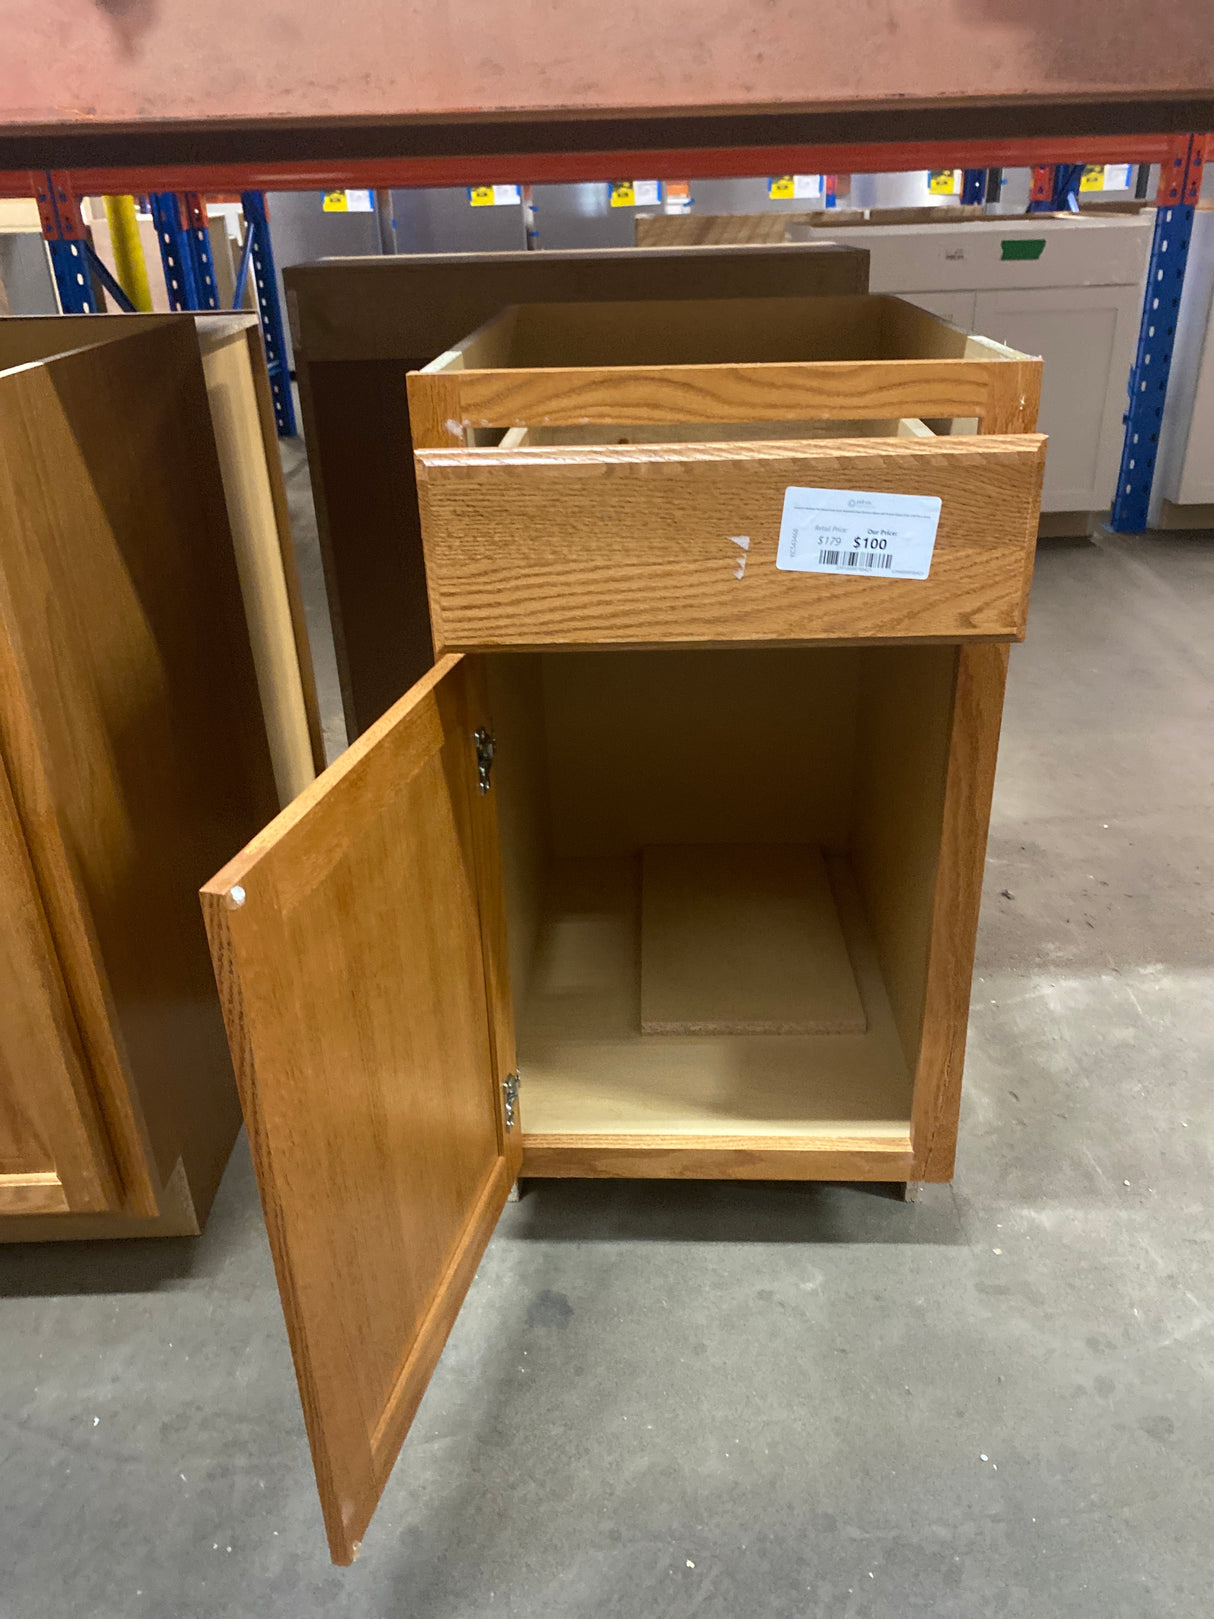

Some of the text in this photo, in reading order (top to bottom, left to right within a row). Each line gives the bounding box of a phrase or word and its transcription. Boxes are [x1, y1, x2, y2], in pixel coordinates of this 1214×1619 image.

[814, 525, 831, 533] Retail
[817, 536, 841, 547] $179
[853, 536, 887, 550] $100
